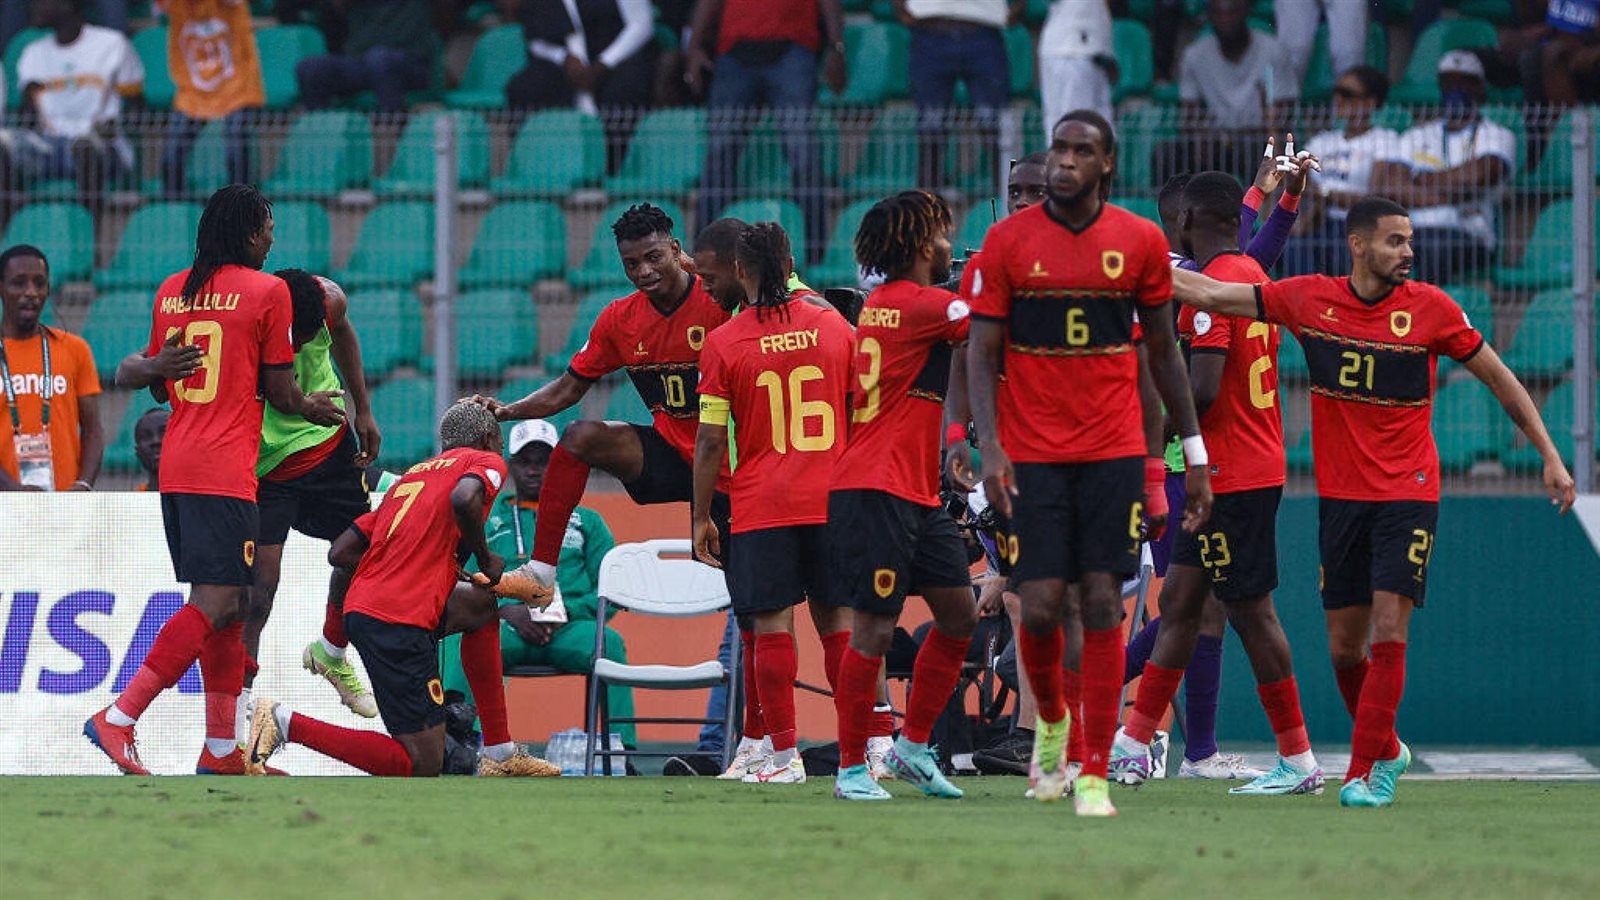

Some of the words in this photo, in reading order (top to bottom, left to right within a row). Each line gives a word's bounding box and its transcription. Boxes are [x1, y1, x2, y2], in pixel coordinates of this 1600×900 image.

[760, 328, 819, 354] FREDY
[1066, 307, 1089, 346] 6
[1338, 351, 1375, 391] 21
[755, 365, 835, 455] 16
[386, 481, 425, 540] 7
[1198, 532, 1231, 568] 23
[0, 590, 206, 694] ISA
